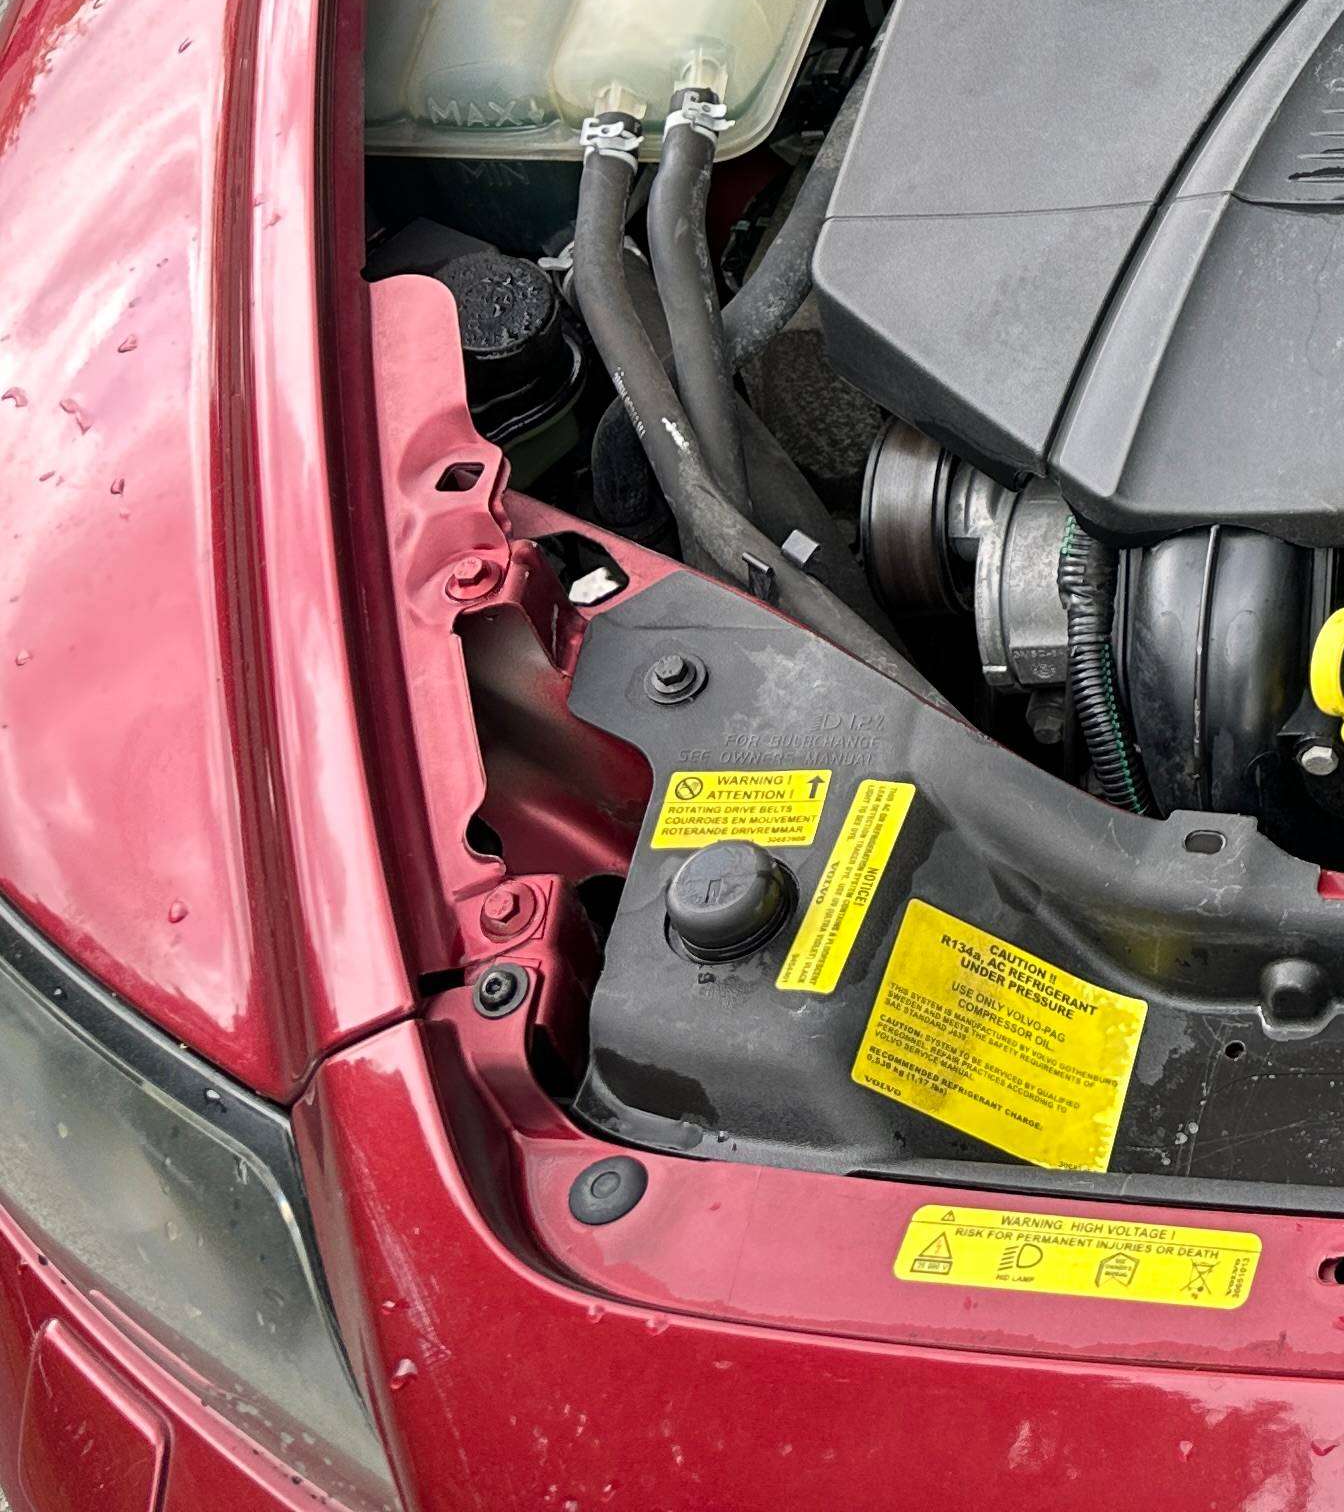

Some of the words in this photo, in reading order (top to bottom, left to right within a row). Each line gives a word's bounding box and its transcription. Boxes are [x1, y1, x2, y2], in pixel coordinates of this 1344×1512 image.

[427, 96, 523, 127] MAX
[705, 789, 785, 800] ATTENTION
[715, 774, 785, 785] WARNING
[663, 816, 729, 825] COURROIES
[731, 815, 746, 824] EN
[748, 814, 817, 823] MOUVEMENT
[667, 805, 722, 814] ROTATING
[723, 805, 756, 813] DRIVE
[758, 804, 793, 813] BELTS
[660, 826, 728, 835] ROTERANDE
[730, 825, 803, 834] DRIVREMMAR
[814, 859, 840, 904] VOLVO
[851, 866, 879, 906] NOTICE!
[988, 943, 1046, 979] CAUTION
[959, 956, 1006, 986] UNDER
[1007, 979, 1074, 1020] PRESSURE
[986, 956, 1006, 974] AC
[1007, 967, 1097, 1016] REFRIGERANT
[889, 981, 909, 995] THIS
[910, 991, 943, 1011] SYSTEM
[943, 1006, 952, 1015] IS
[953, 1011, 1018, 1047] MANUFACTURED
[1019, 1043, 1030, 1053] BY
[1031, 1048, 1058, 1066] VOLVO
[902, 1005, 947, 1031] STANDARD
[950, 981, 974, 999] USE
[975, 992, 1004, 1013] ONLY
[1005, 1007, 1066, 1043] VOLVO-PAG
[957, 997, 1033, 1041] COMPRESSOR
[873, 1029, 902, 1047] VOLVO
[903, 1042, 938, 1064] SERVICE
[886, 989, 922, 1011] SWEDEN
[923, 1006, 941, 1019] AND
[942, 1015, 969, 1032] MEETS
[971, 1028, 987, 1041] THE
[988, 1036, 1018, 1055] SAFETY
[1020, 1051, 1081, 1084] REQUIREMENTS
[1082, 1079, 1095, 1089] OF
[862, 1073, 902, 1097] VOLVO
[868, 1045, 939, 1082] RECOMMENDED
[940, 1077, 1003, 1112] REFRIGERANT
[924, 1033, 957, 1054] SYSTEM
[958, 1049, 970, 1060] TO
[970, 1055, 983, 1066] BE
[983, 1061, 1023, 1085] SERVICED
[1024, 1080, 1035, 1091] BY
[1036, 1086, 1080, 1109] QUALIFIED
[929, 1045, 960, 1064] REPAIR
[960, 1059, 1006, 1086] PRACTICES
[1006, 1081, 1054, 1108] ACCORDING
[1056, 1104, 1067, 1114] TO
[953, 1227, 985, 1238] RISK
[986, 1229, 1014, 1241] FOR
[1015, 1232, 1093, 1248] PERMANENT
[1095, 1239, 1153, 1253] INJURIES
[1155, 1244, 1176, 1255] OR
[1176, 1246, 1220, 1259] DEATH
[999, 1215, 1064, 1231] WARNING
[1069, 1221, 1104, 1234] HIGH
[1107, 1224, 1169, 1240] VOLTAGE
[1011, 1274, 1035, 1283] LAMP
